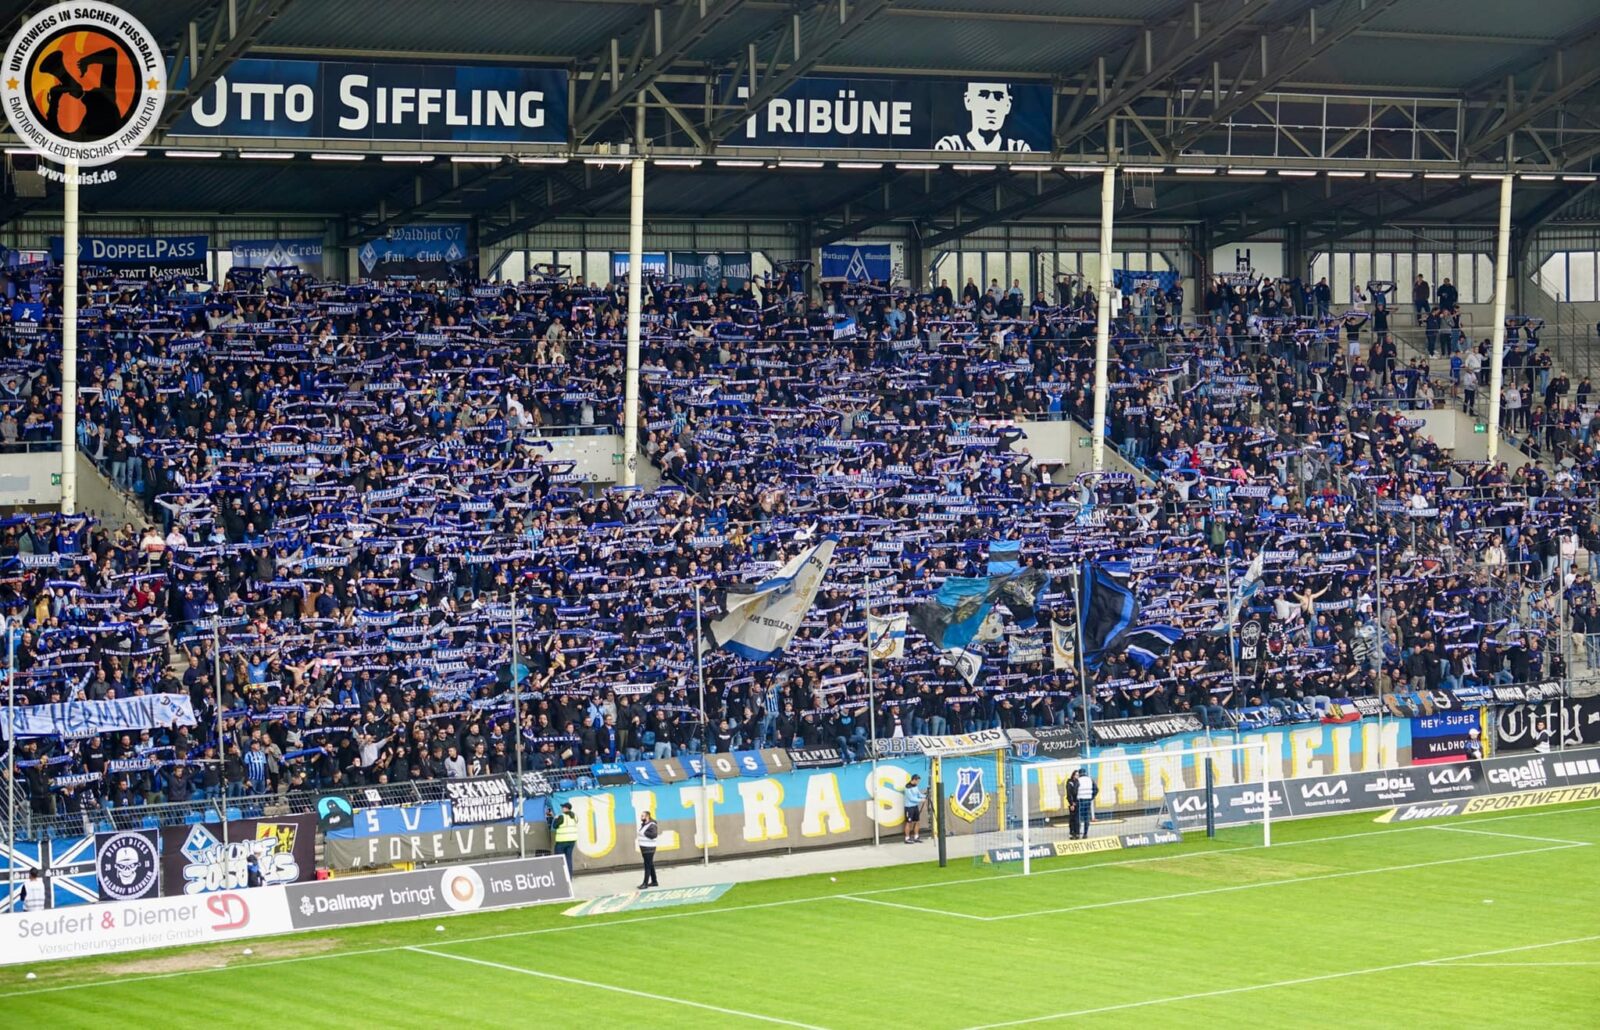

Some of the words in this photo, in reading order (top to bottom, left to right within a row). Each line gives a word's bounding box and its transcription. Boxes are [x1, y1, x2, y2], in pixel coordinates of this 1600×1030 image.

[338, 74, 545, 131] SIFFLING
[390, 227, 442, 242] Waldhof
[445, 227, 462, 241] 07
[232, 245, 270, 258] Crazy
[287, 245, 323, 257] Crew
[416, 251, 442, 262] Club
[119, 268, 146, 278] STATT
[1446, 714, 1475, 726] SUPER
[1429, 740, 1467, 753] WALDHO
[57, 772, 101, 785] BARACKLER
[1428, 766, 1473, 785] KIA
[1488, 759, 1546, 787] capelli
[447, 778, 511, 799] SEKTION
[1300, 779, 1348, 798] KIA
[1517, 778, 1548, 789] SPORT
[453, 802, 513, 823] MANNHEIM
[569, 765, 911, 858] ULTRAS
[1399, 803, 1459, 820] bwin
[995, 850, 1022, 862] bwin
[1056, 838, 1119, 854] SPORTWETTEN
[1126, 834, 1149, 846] bwin
[1153, 832, 1178, 844] bwin
[315, 891, 384, 914] Dallmayr
[390, 884, 436, 905] bringt
[490, 877, 513, 893] ins
[516, 870, 556, 889] Büro!
[18, 913, 93, 938] Seufert
[100, 911, 116, 929] &
[123, 903, 199, 928] Diemer
[38, 931, 163, 954] Versicherungsmakler
[166, 928, 204, 941] GmbH
